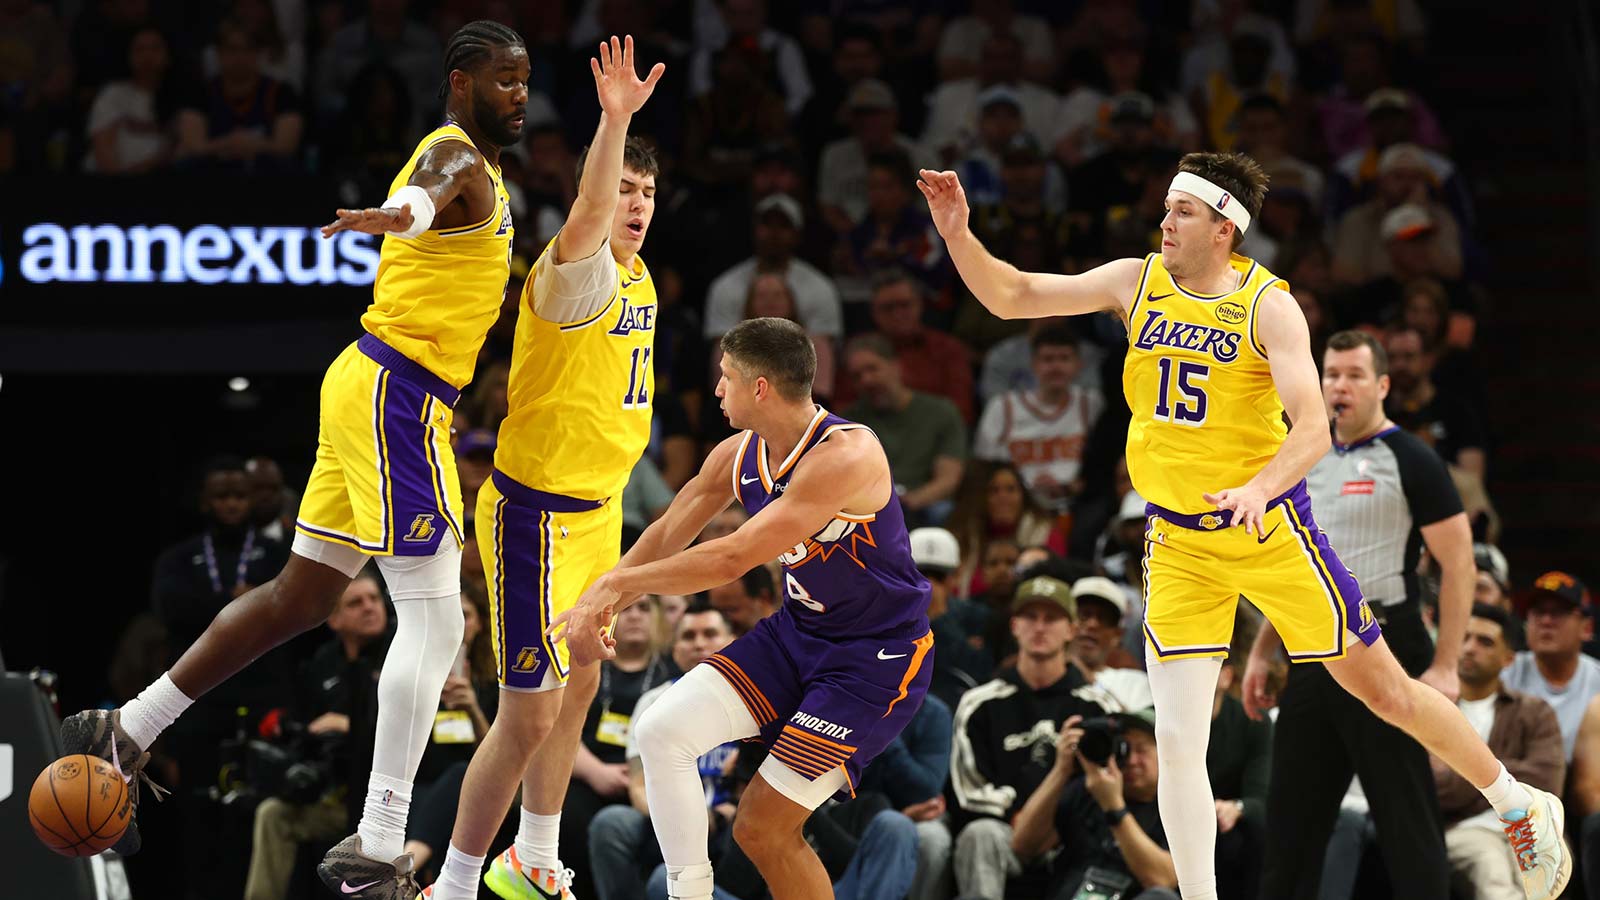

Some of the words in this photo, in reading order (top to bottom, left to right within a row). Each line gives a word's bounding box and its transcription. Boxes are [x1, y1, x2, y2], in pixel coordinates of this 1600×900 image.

[20, 222, 380, 285] annexus
[1134, 310, 1242, 363] LAKERS
[1218, 306, 1246, 319] bibigo
[1154, 357, 1210, 425] 15
[790, 711, 853, 741] PHOENIX
